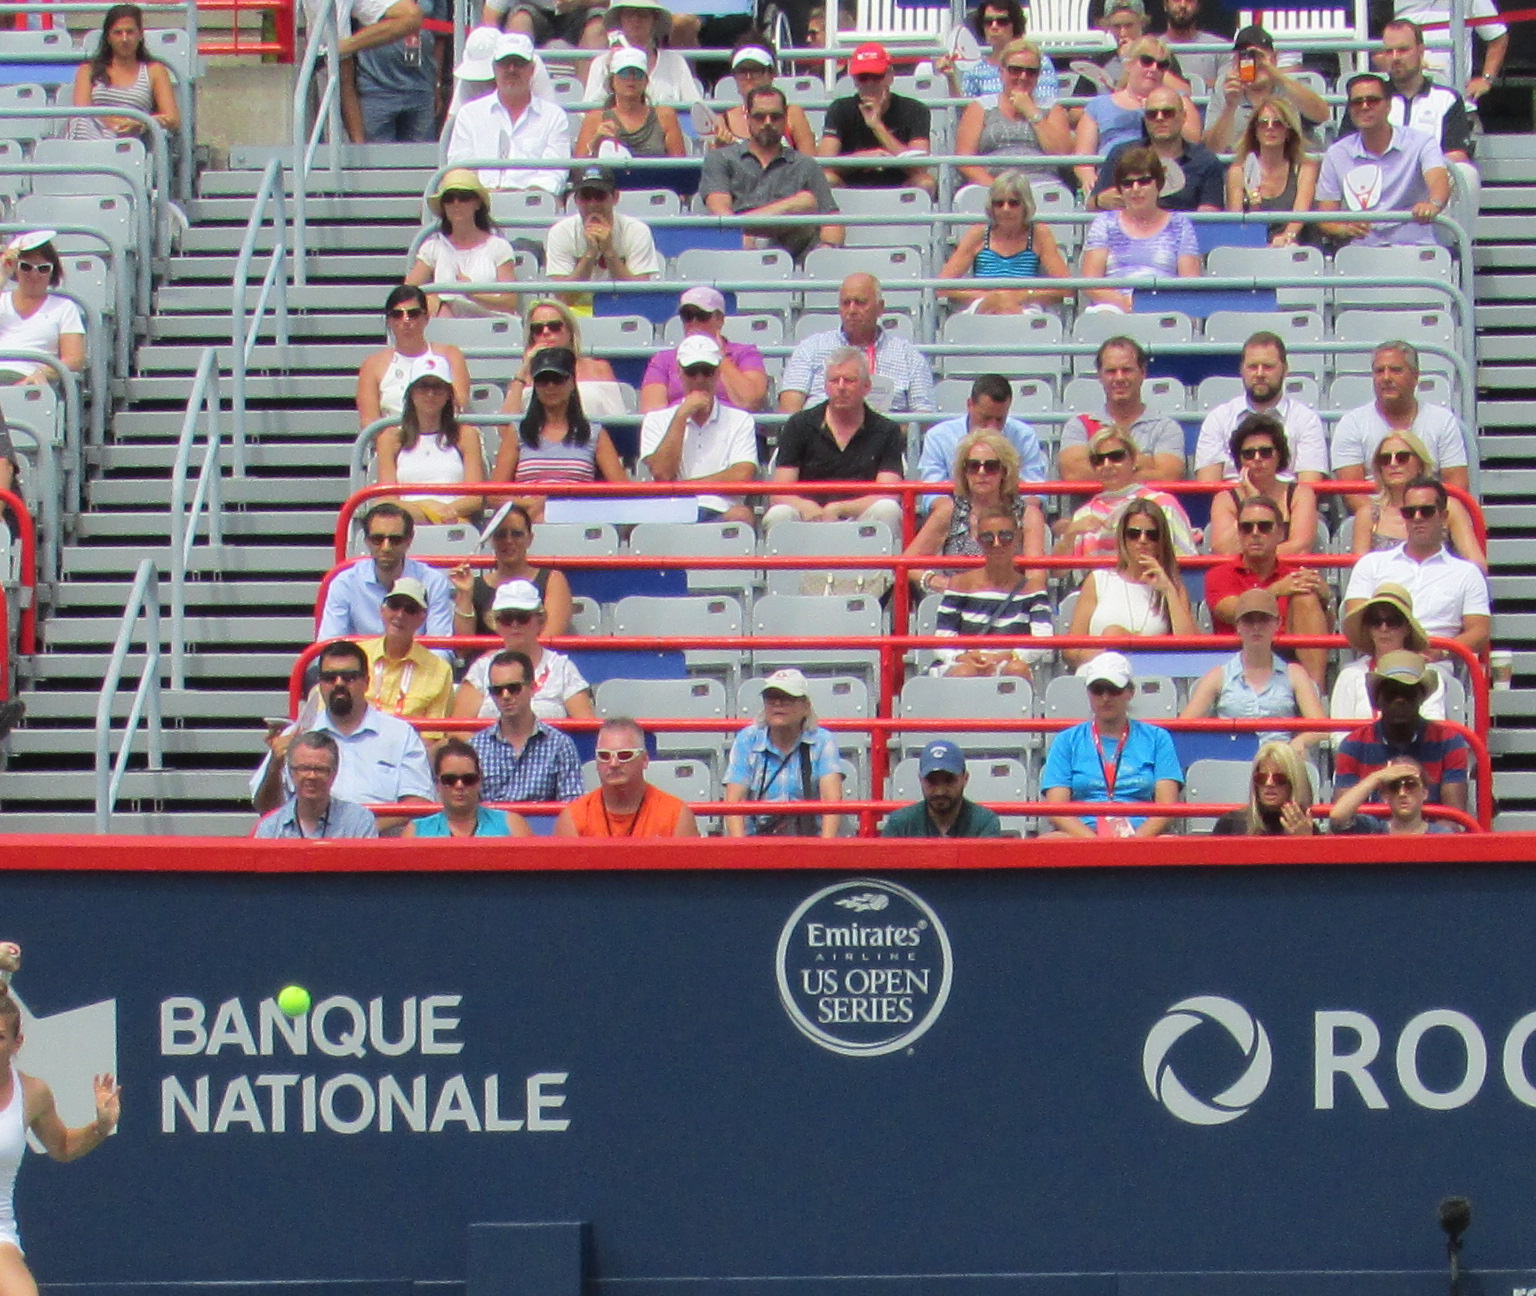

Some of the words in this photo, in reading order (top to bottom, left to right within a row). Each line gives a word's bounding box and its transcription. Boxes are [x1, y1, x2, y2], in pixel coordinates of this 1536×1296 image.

[815, 952, 916, 961] AIRLINE
[801, 969, 839, 995] US
[845, 969, 931, 995] OPEN
[818, 997, 913, 1024] SERIES
[161, 995, 465, 1059] BANQUE
[162, 1073, 571, 1134] NATIONALE
